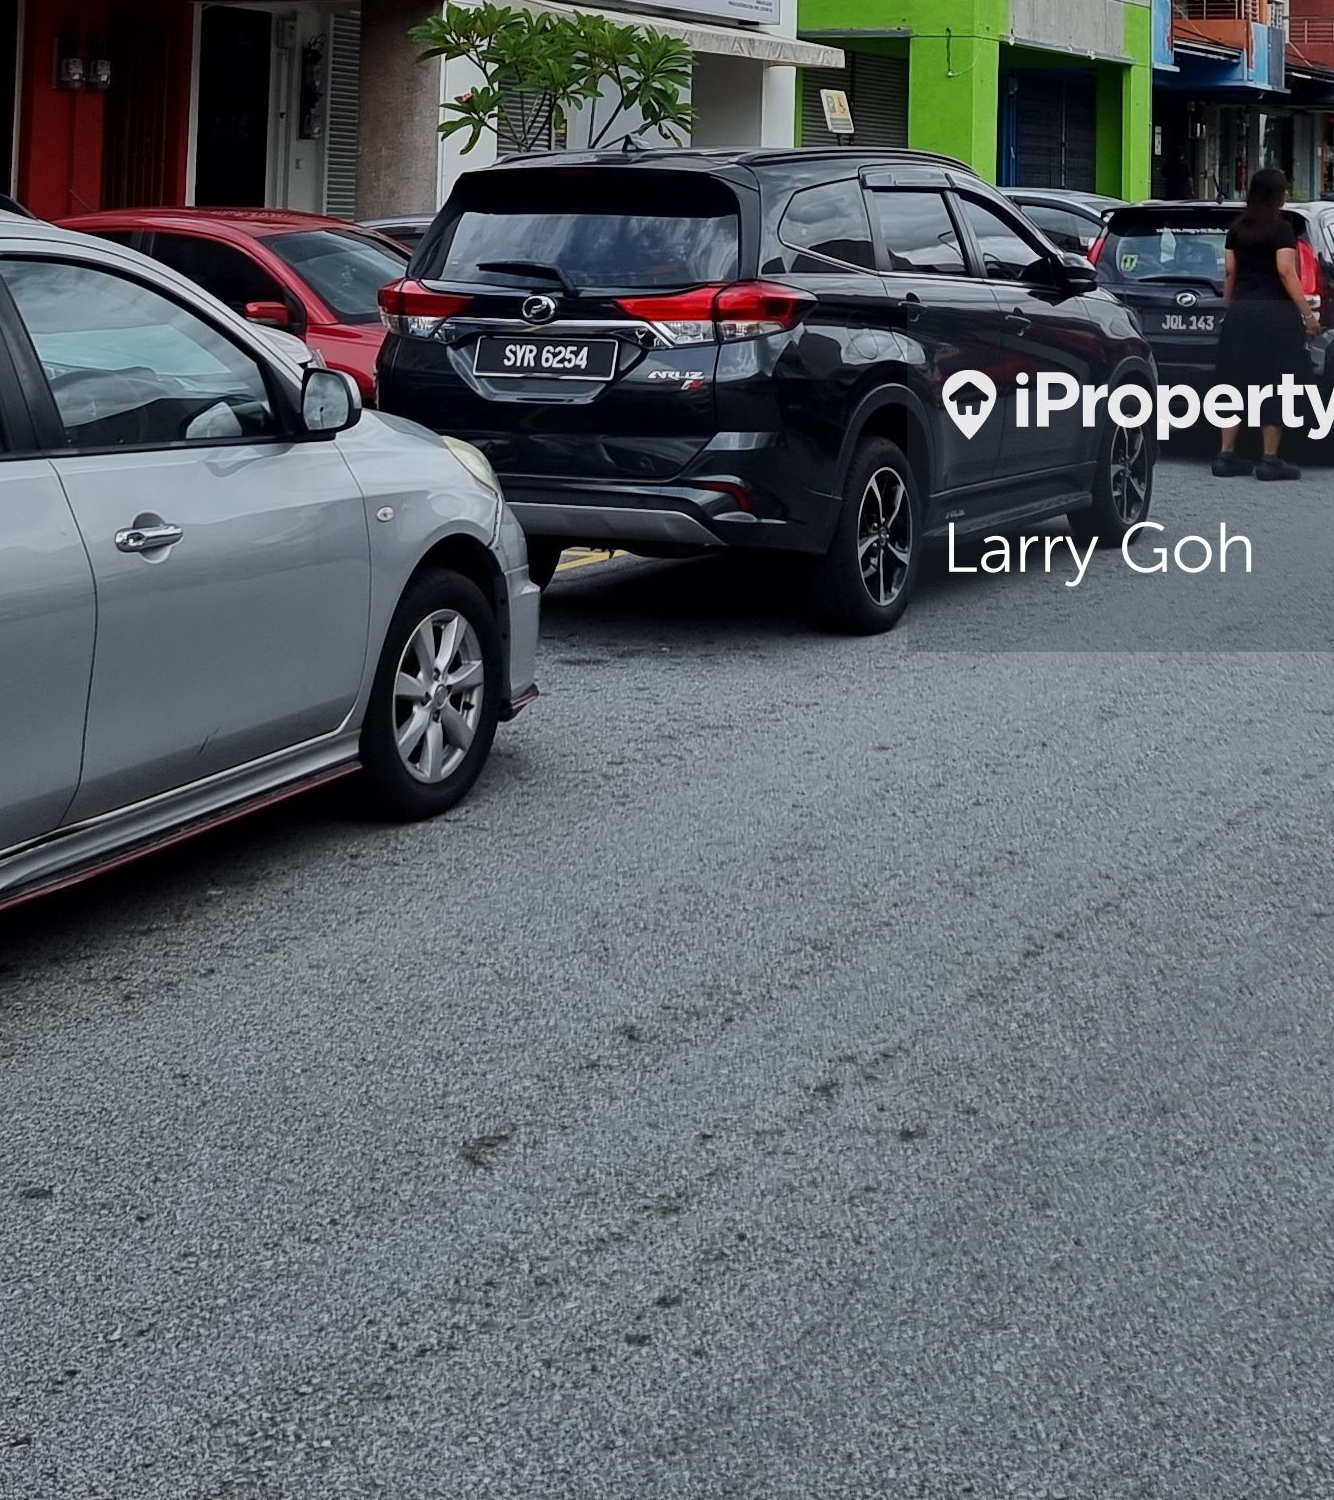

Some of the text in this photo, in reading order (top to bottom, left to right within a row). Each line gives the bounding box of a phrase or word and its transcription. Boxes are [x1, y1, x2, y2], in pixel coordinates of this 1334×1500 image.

[1161, 314, 1215, 331] JQL 143
[503, 345, 589, 371] SYR 6254
[647, 370, 705, 381] ARUZ
